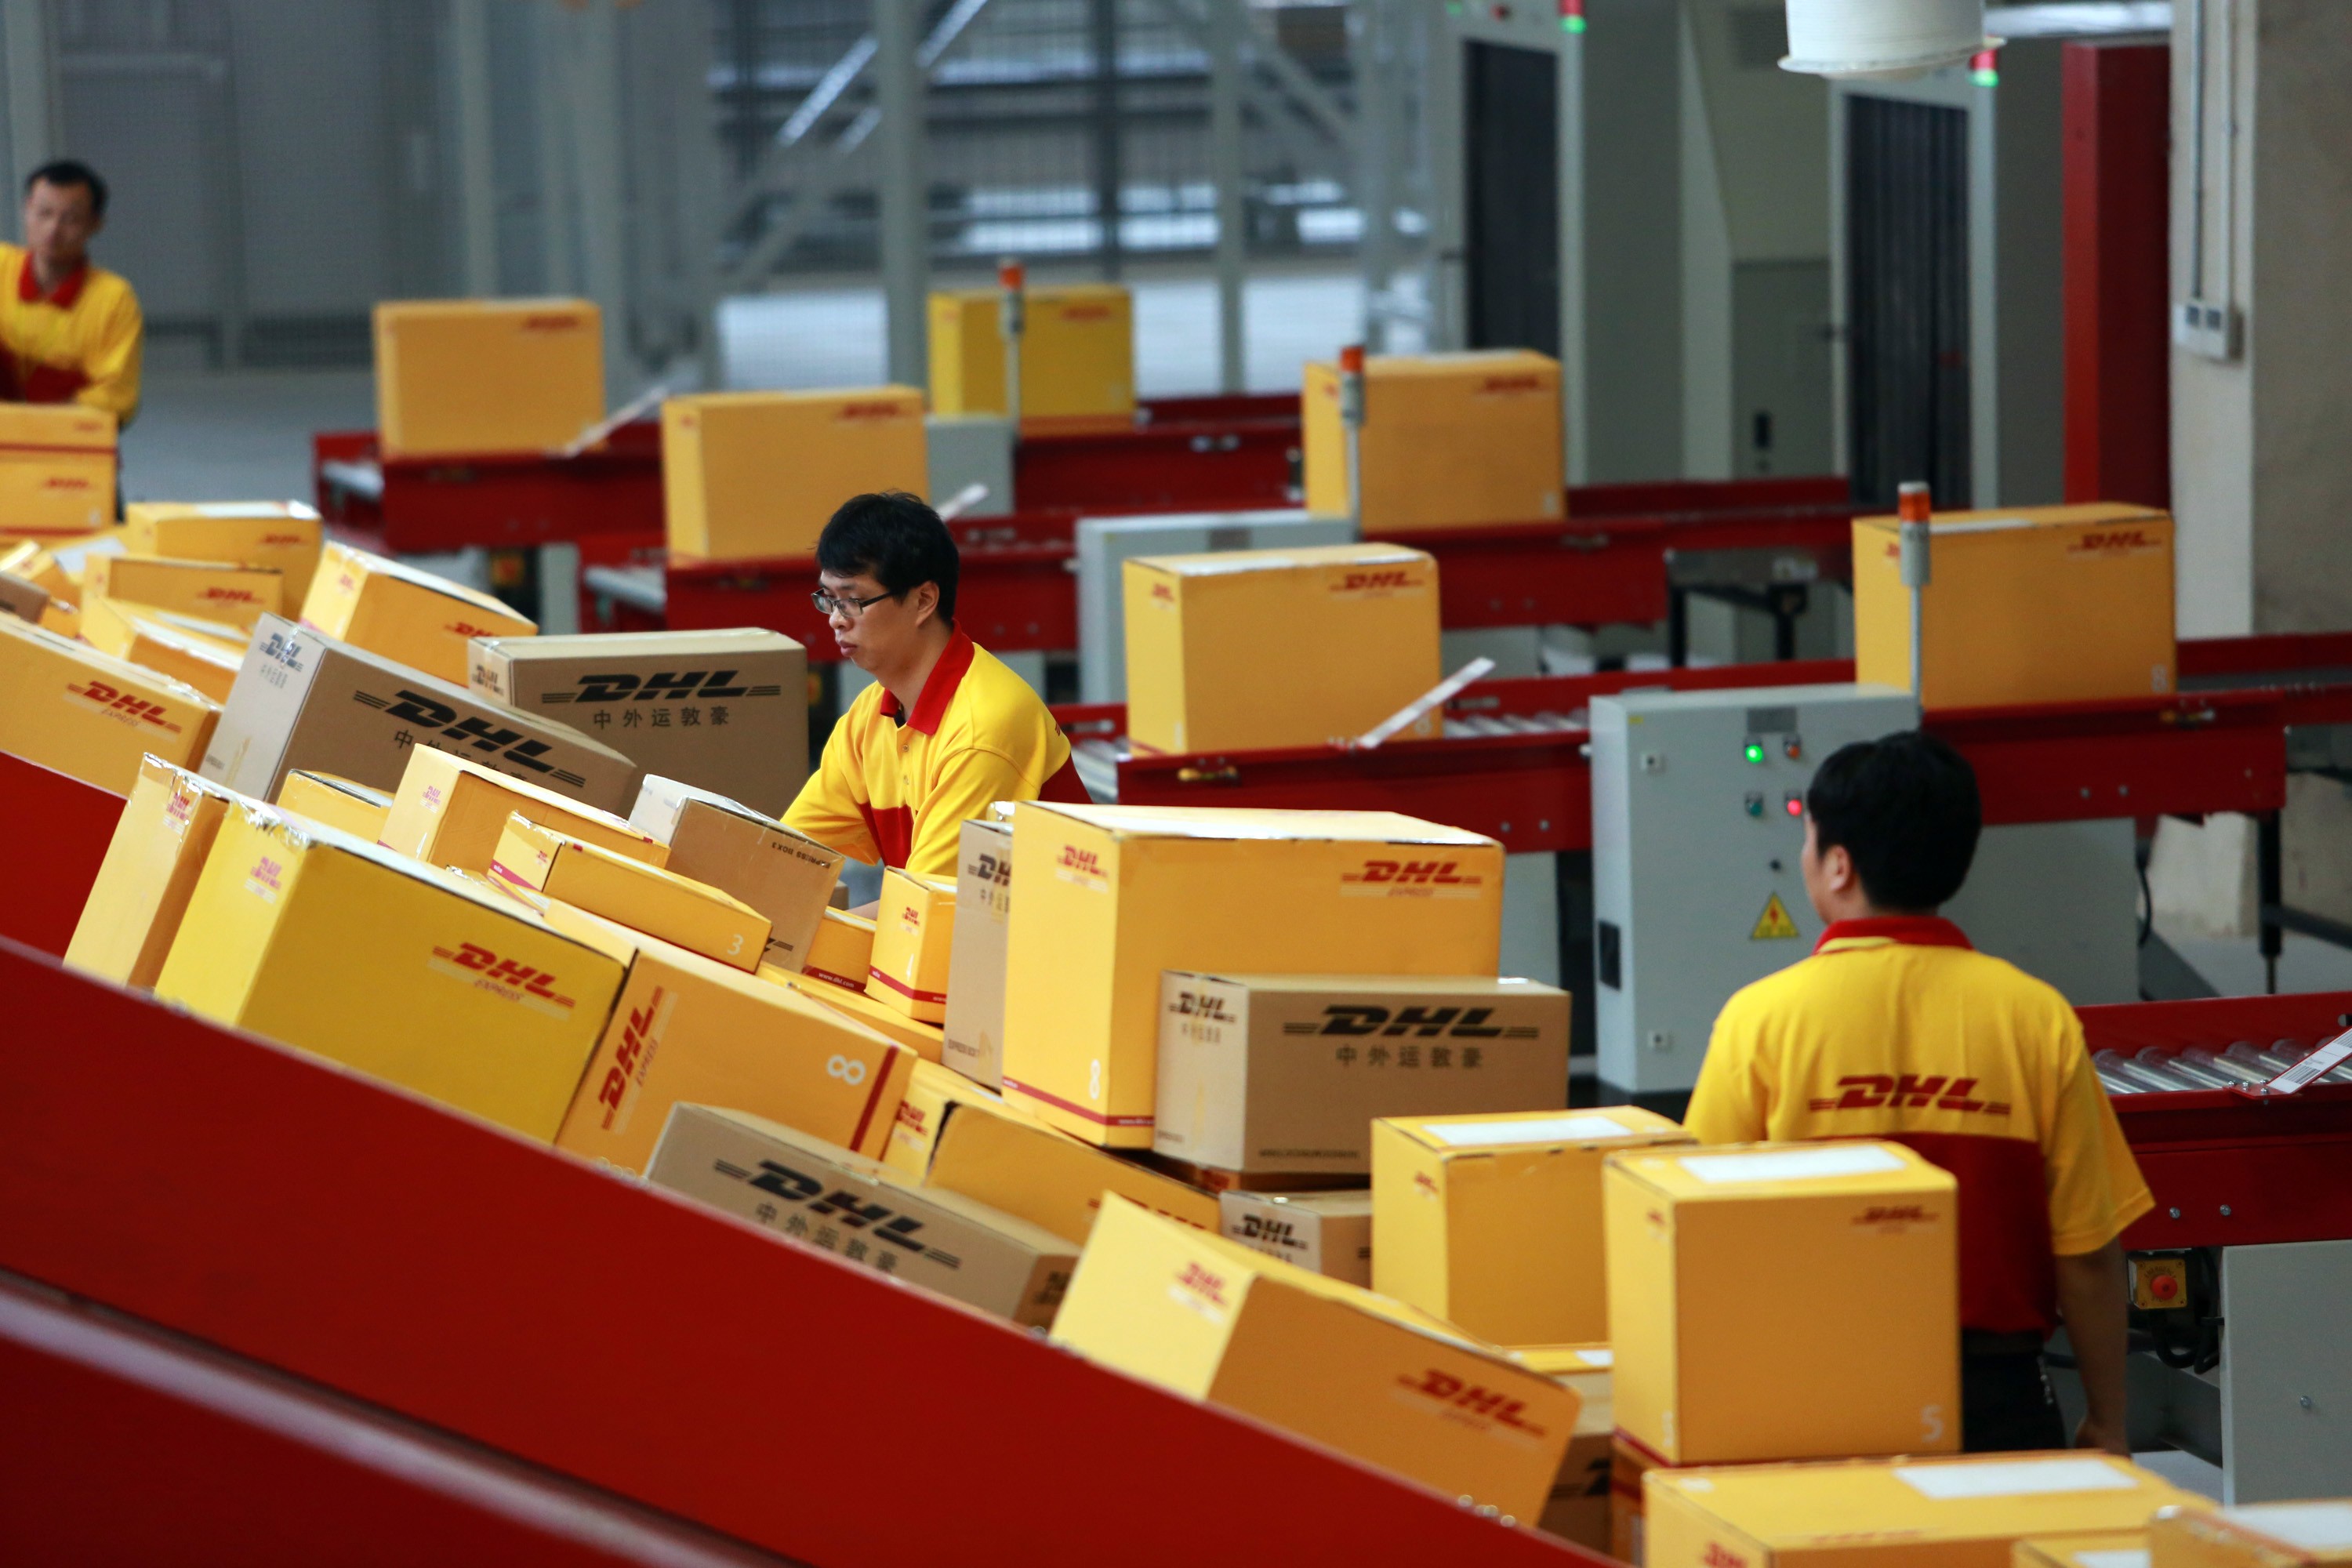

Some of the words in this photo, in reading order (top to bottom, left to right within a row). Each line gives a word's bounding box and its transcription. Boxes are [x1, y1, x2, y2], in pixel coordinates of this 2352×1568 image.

[575, 670, 749, 702] DHL
[83, 681, 166, 726] DHL
[593, 706, 730, 729] 中外运敦豪
[385, 690, 554, 773] DHL
[978, 853, 1011, 887] DH
[1063, 844, 1099, 875] DHL
[1362, 860, 1461, 884] DHL
[728, 934, 744, 956] 3
[452, 942, 556, 999] DHL
[818, 971, 855, 989] www.dhl.com
[1179, 991, 1225, 1021] DHL
[1319, 1004, 1502, 1038] DHL
[598, 1007, 655, 1111] DHL
[826, 1054, 866, 1086] 8
[1836, 1073, 1985, 1112] DHL
[750, 1159, 926, 1252] DHL
[1242, 1214, 1297, 1247] DHL
[1420, 1368, 1526, 1428] DHL
[1920, 1404, 1944, 1443] 5
